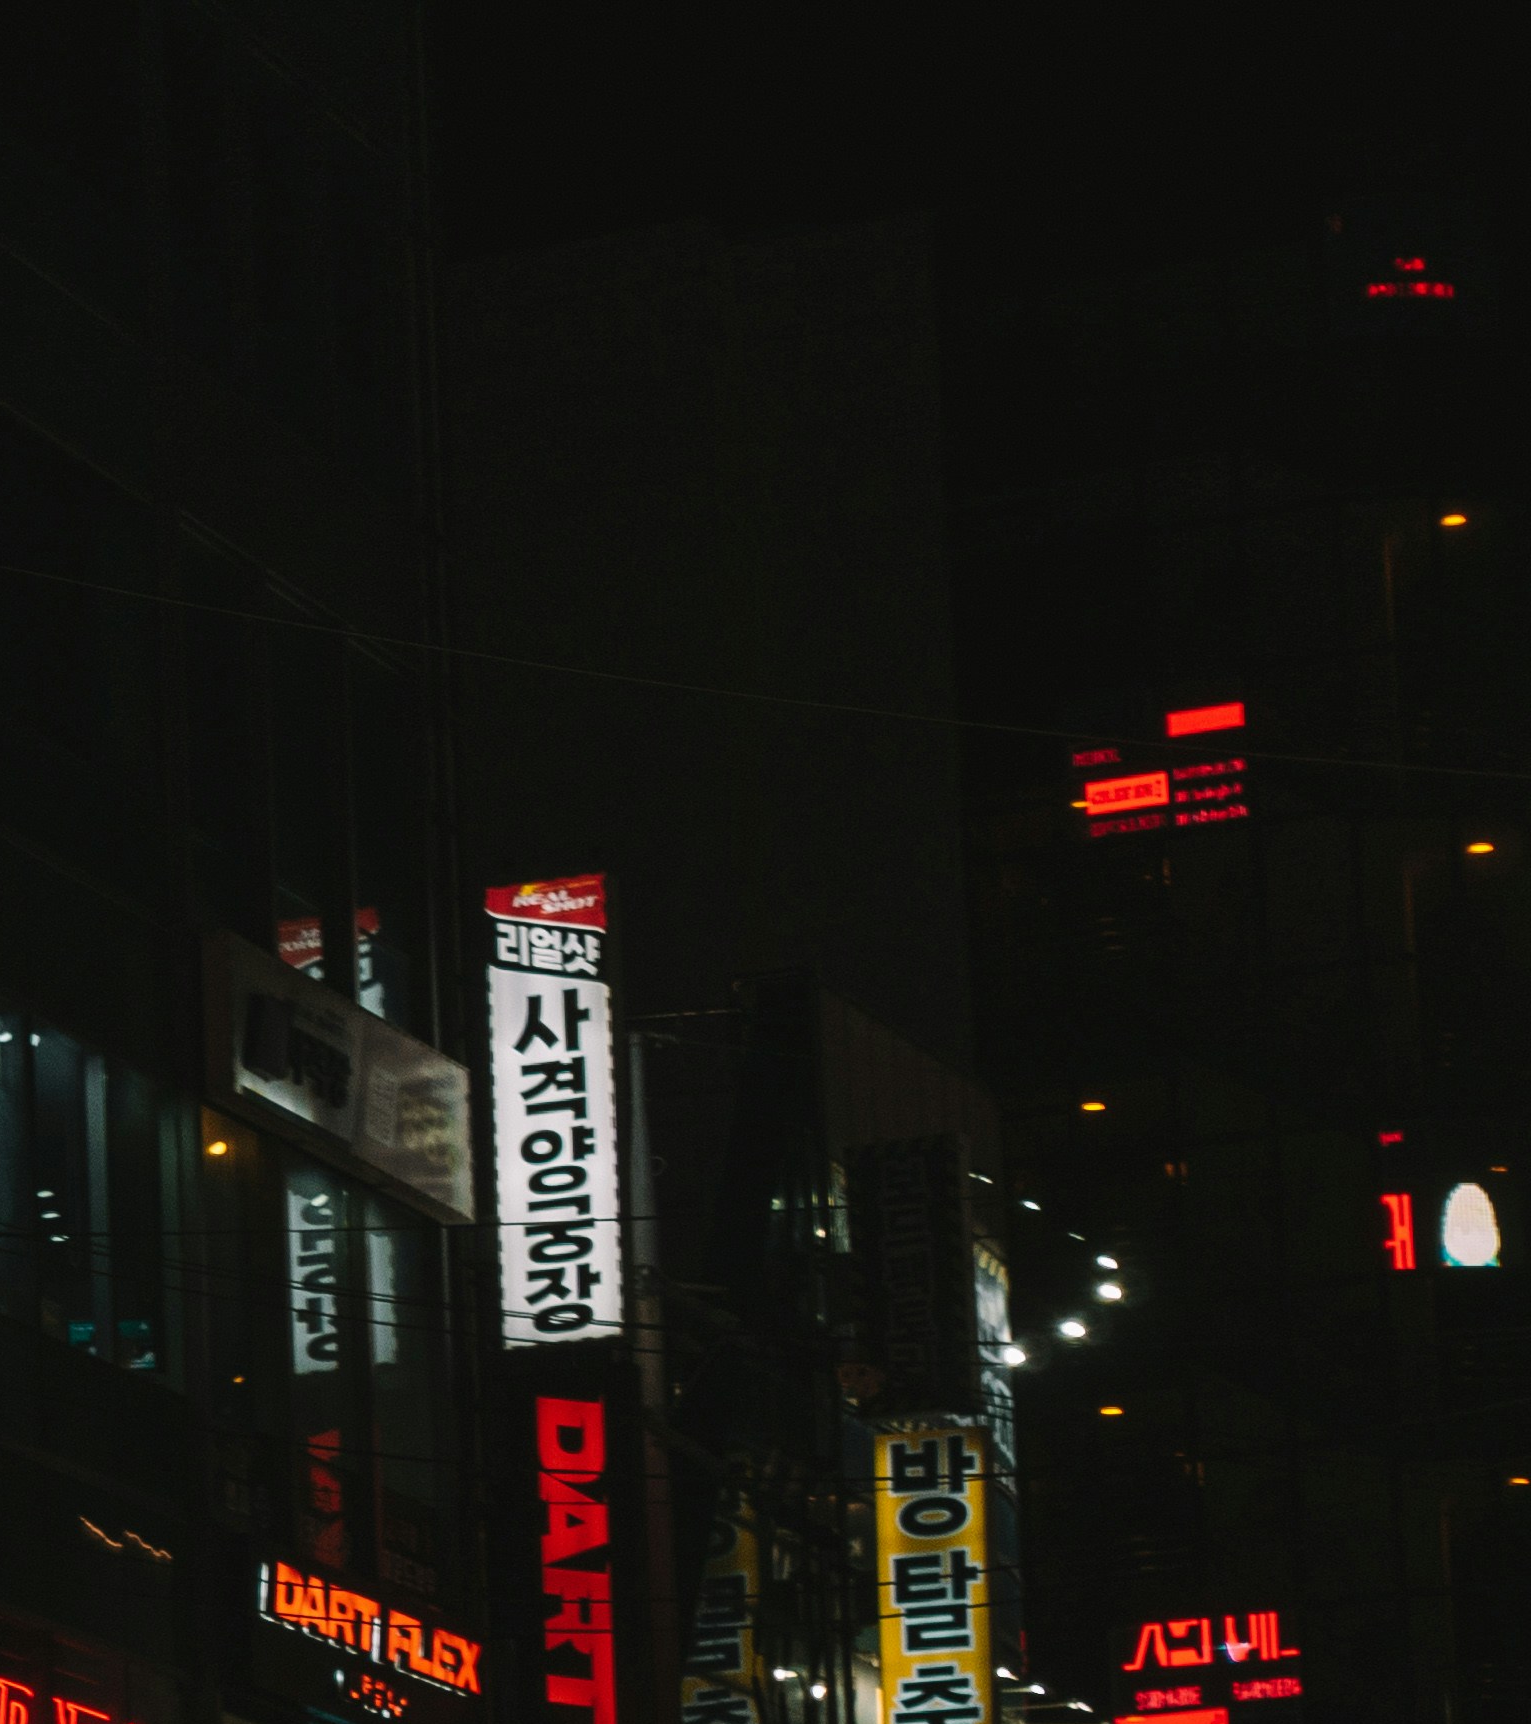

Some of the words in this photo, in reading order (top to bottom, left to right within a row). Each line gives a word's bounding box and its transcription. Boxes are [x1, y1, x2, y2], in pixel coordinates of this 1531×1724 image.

[496, 922, 601, 977] 리얼샷
[274, 1561, 382, 1655] DART
[386, 1608, 483, 1696] FLEX
